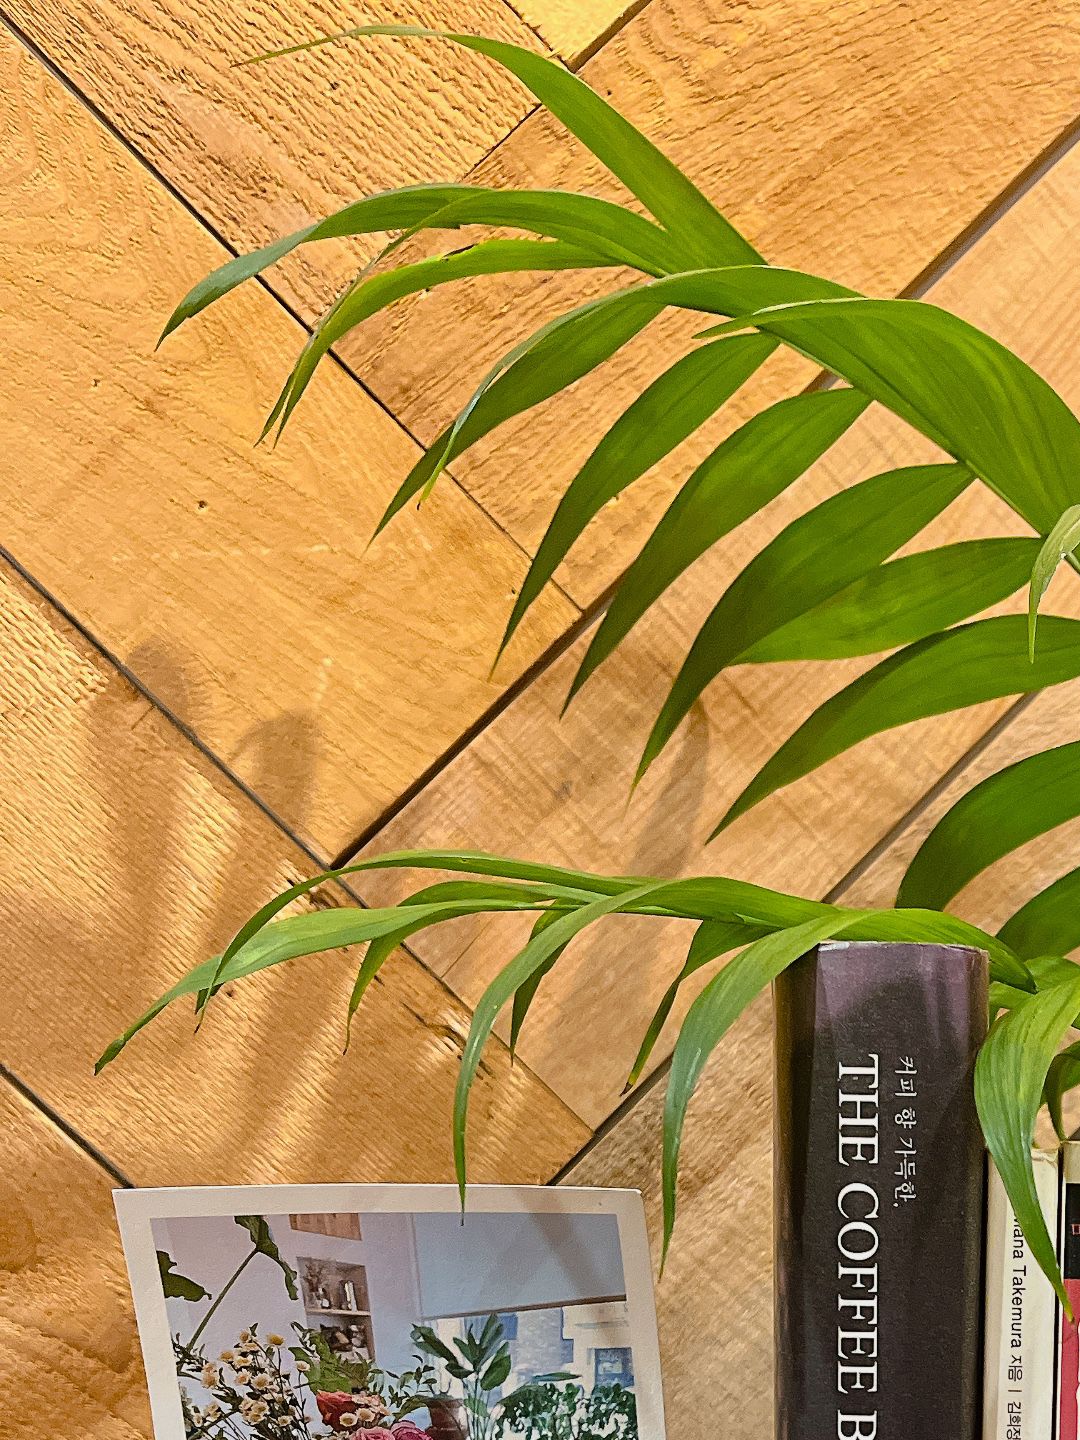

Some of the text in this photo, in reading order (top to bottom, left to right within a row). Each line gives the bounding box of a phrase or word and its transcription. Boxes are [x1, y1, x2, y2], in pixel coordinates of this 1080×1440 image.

[837, 1053, 879, 1166] THE
[892, 1056, 918, 1208] 커피 향 가득한.
[837, 1182, 879, 1394] COFFEE
[1010, 1265, 1027, 1349] Takemura
[1008, 1354, 1023, 1382] 지음
[1006, 1401, 1022, 1440] 김희정
